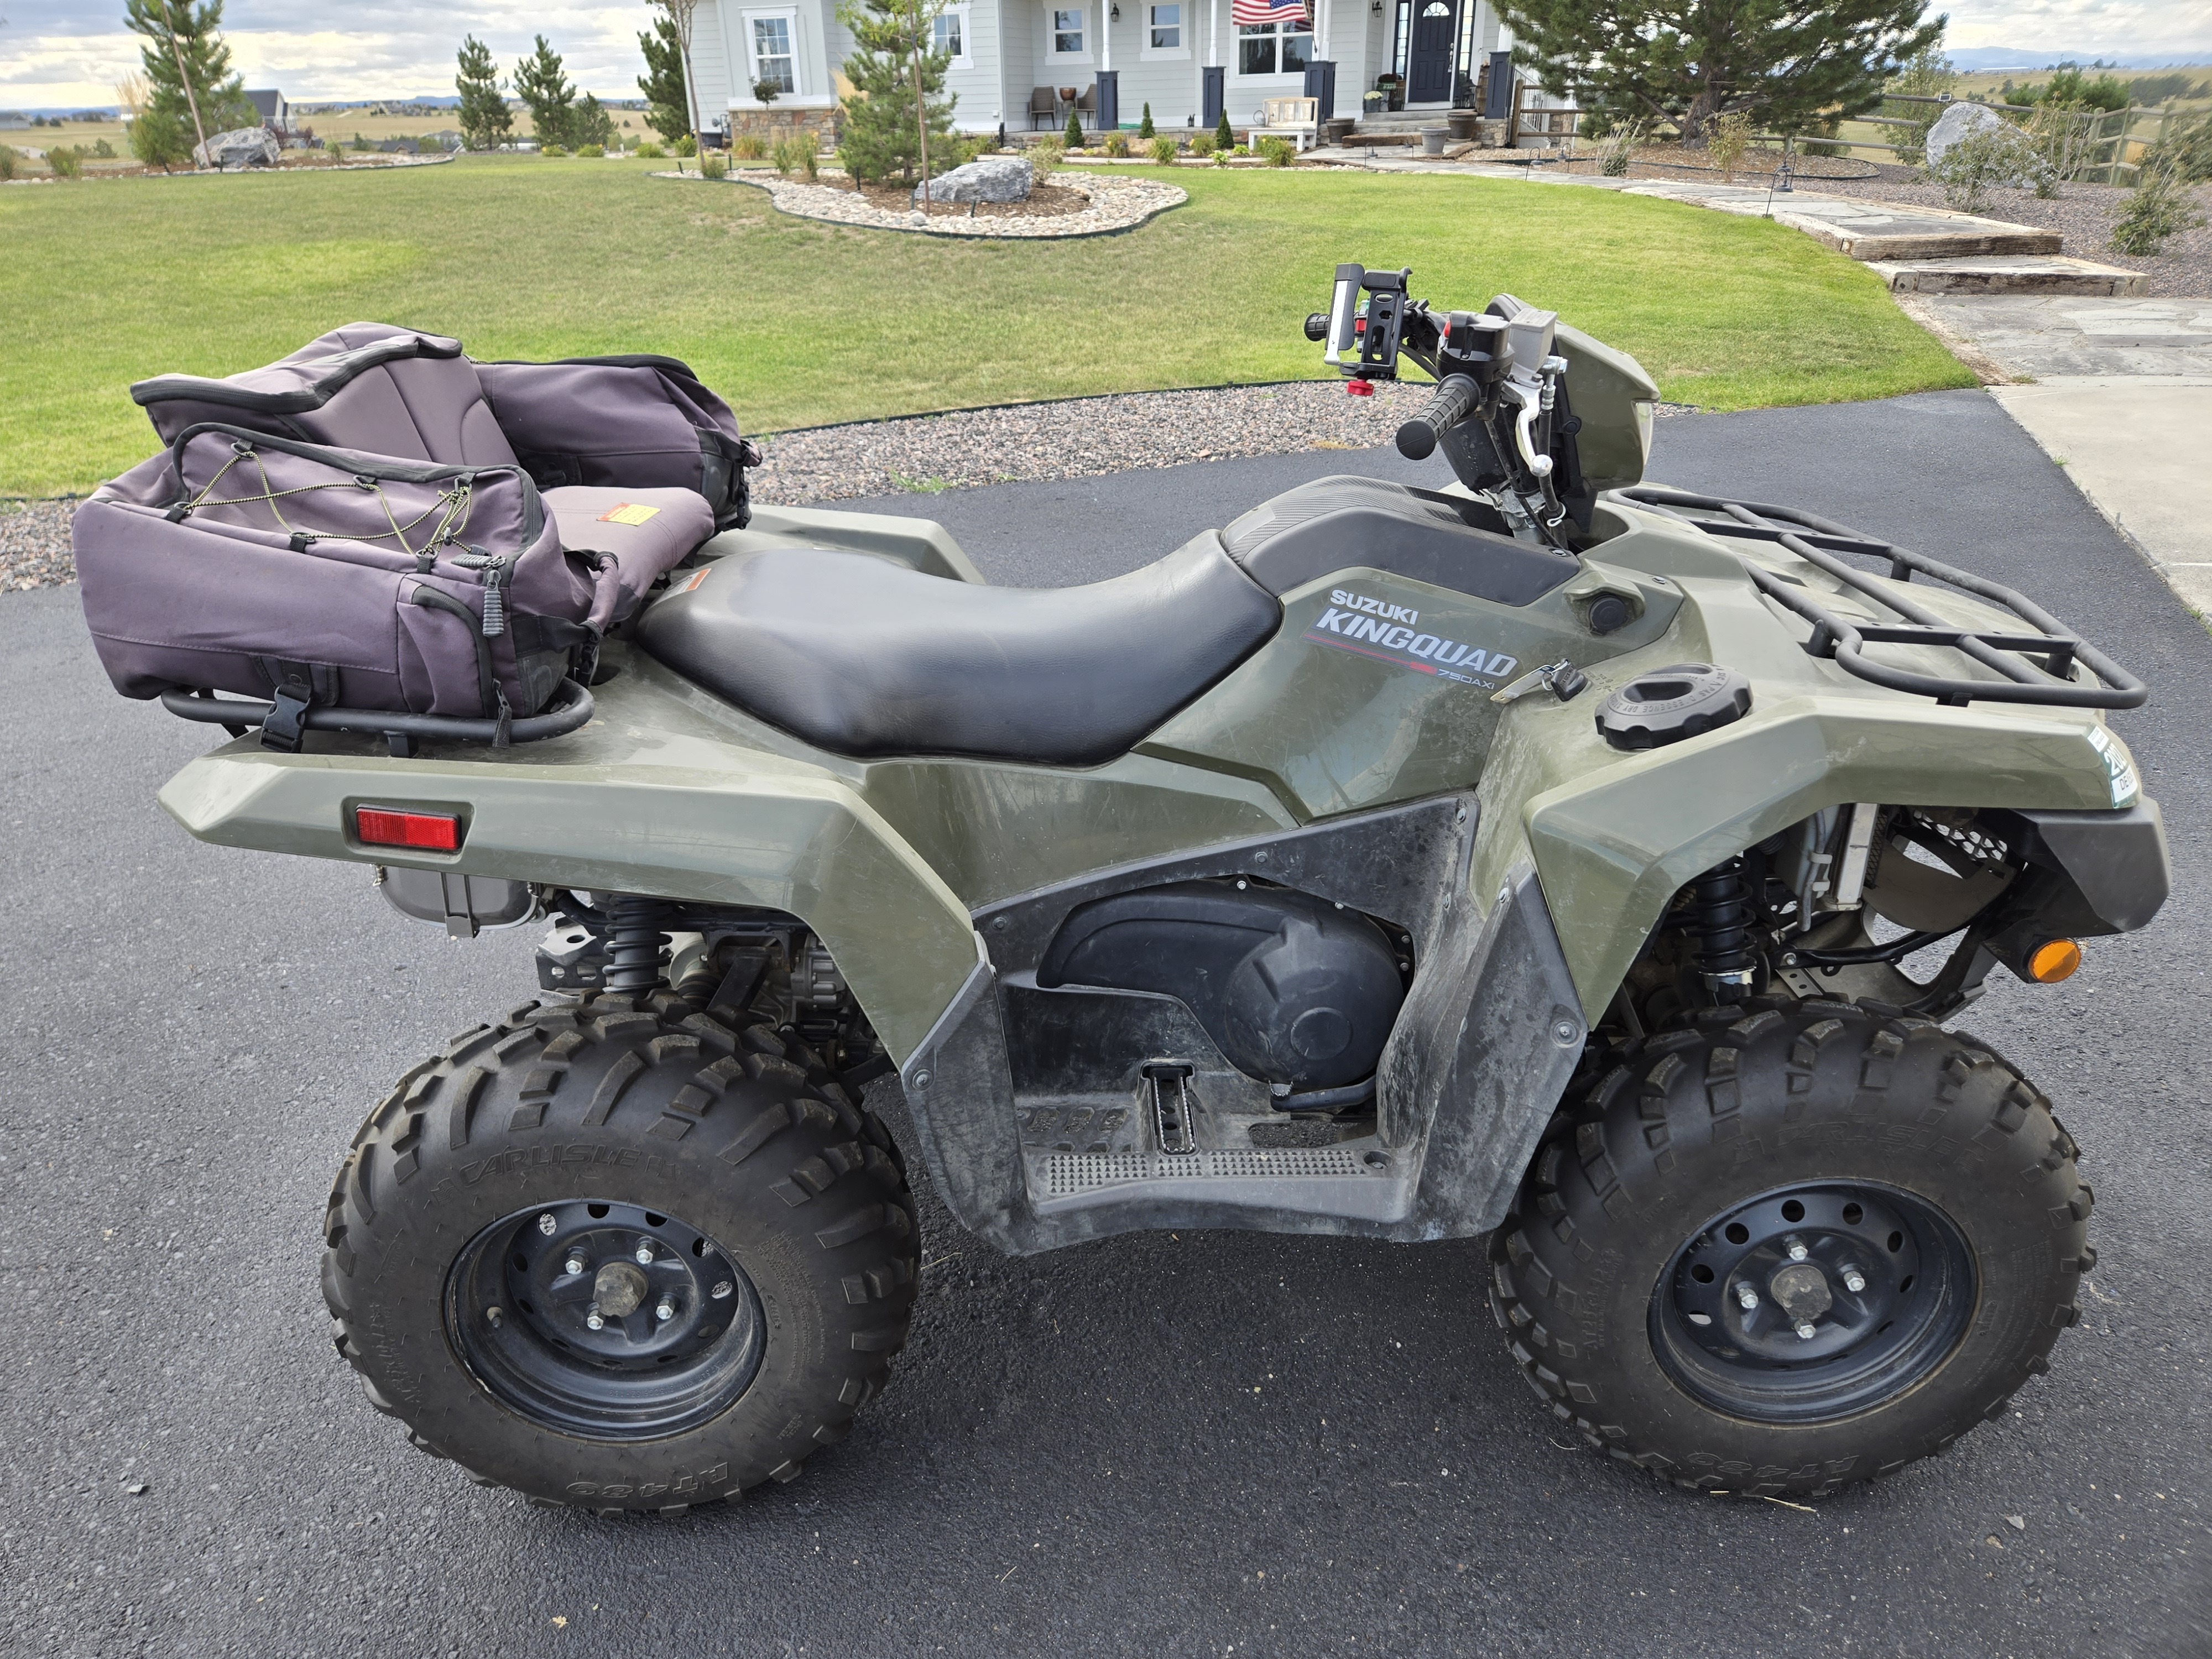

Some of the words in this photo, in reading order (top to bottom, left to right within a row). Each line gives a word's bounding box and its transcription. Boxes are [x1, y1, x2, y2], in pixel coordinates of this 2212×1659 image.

[1330, 588, 1420, 625] SUZUKI
[1316, 607, 1517, 677] KINGQUAD
[1438, 668, 1495, 690] 750AXi
[459, 1144, 642, 1187] CARLISLE
[566, 1462, 728, 1498] AT489
[1687, 1452, 1860, 1479] AT489
